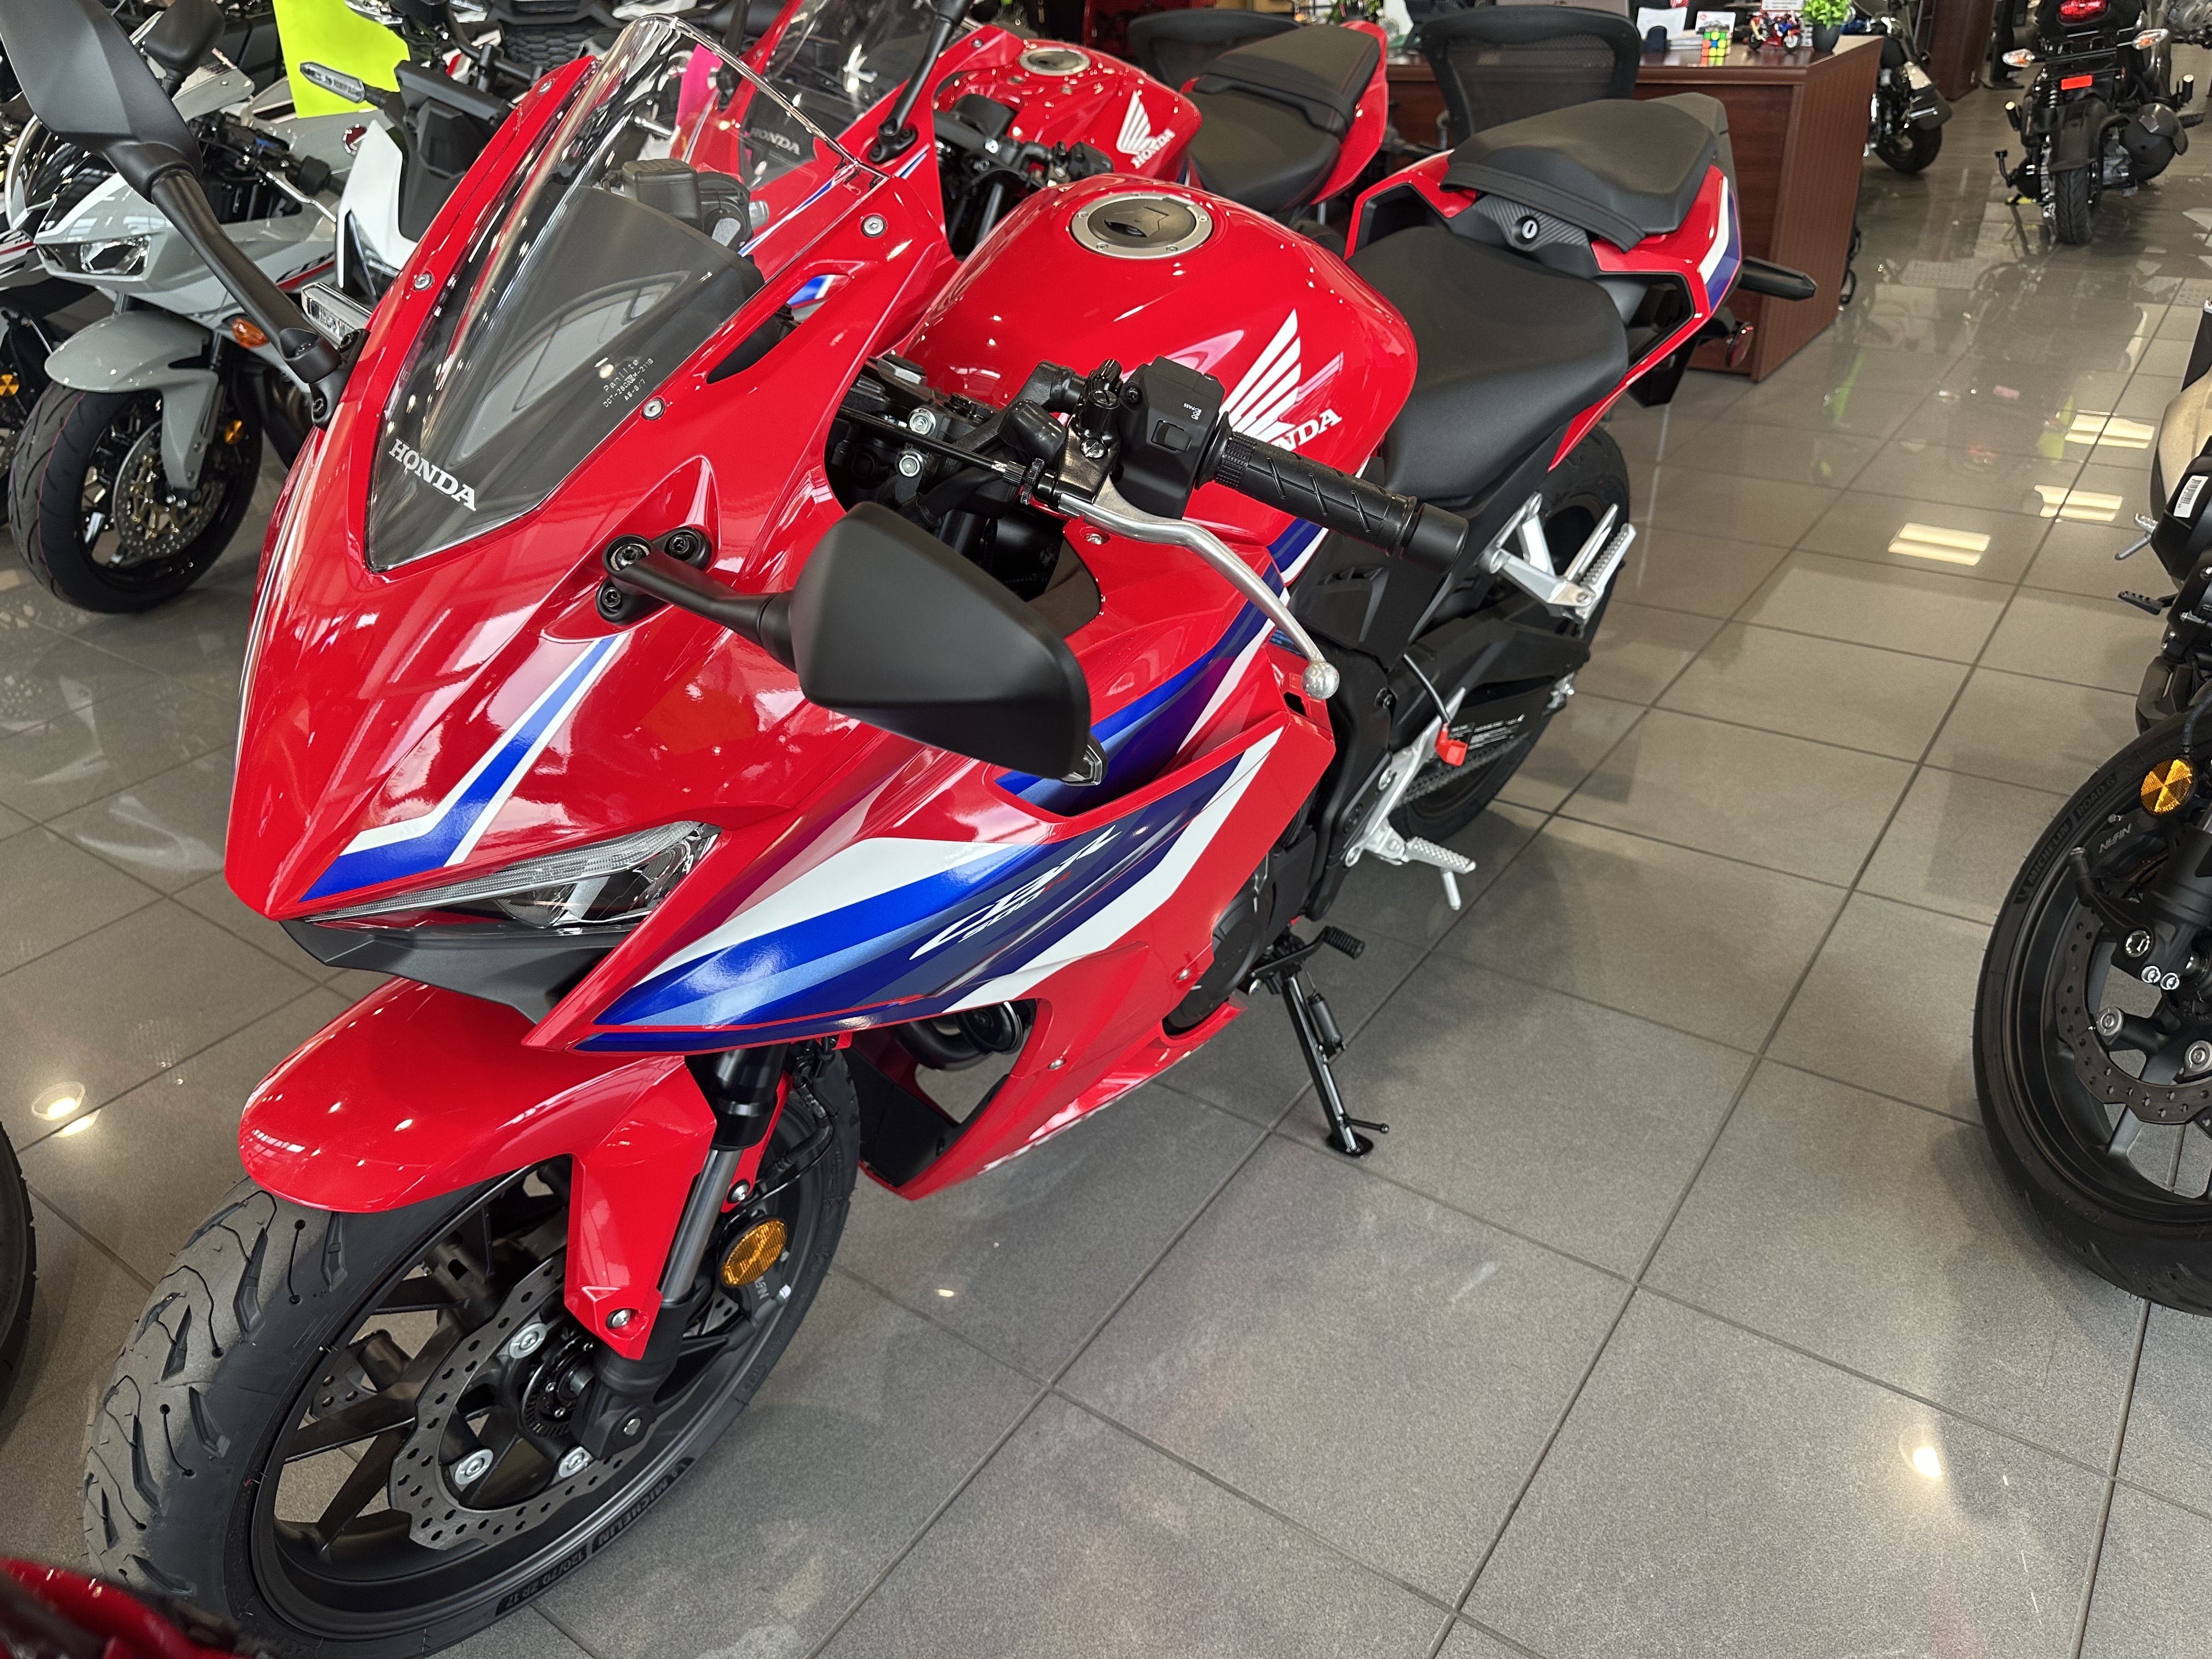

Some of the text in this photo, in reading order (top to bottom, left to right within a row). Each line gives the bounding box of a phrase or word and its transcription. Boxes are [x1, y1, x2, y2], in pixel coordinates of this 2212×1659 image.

[749, 127, 801, 156] HONDA
[1130, 128, 1176, 170] HONDA
[603, 359, 639, 393] Panlite
[1183, 403, 1195, 411] PASS
[1270, 408, 1343, 452] NDA
[388, 438, 477, 512] HONDA
[2076, 786, 2106, 816] ROAD
[2029, 822, 2071, 884] MICHELIN
[597, 1476, 669, 1547] MICHELIN
